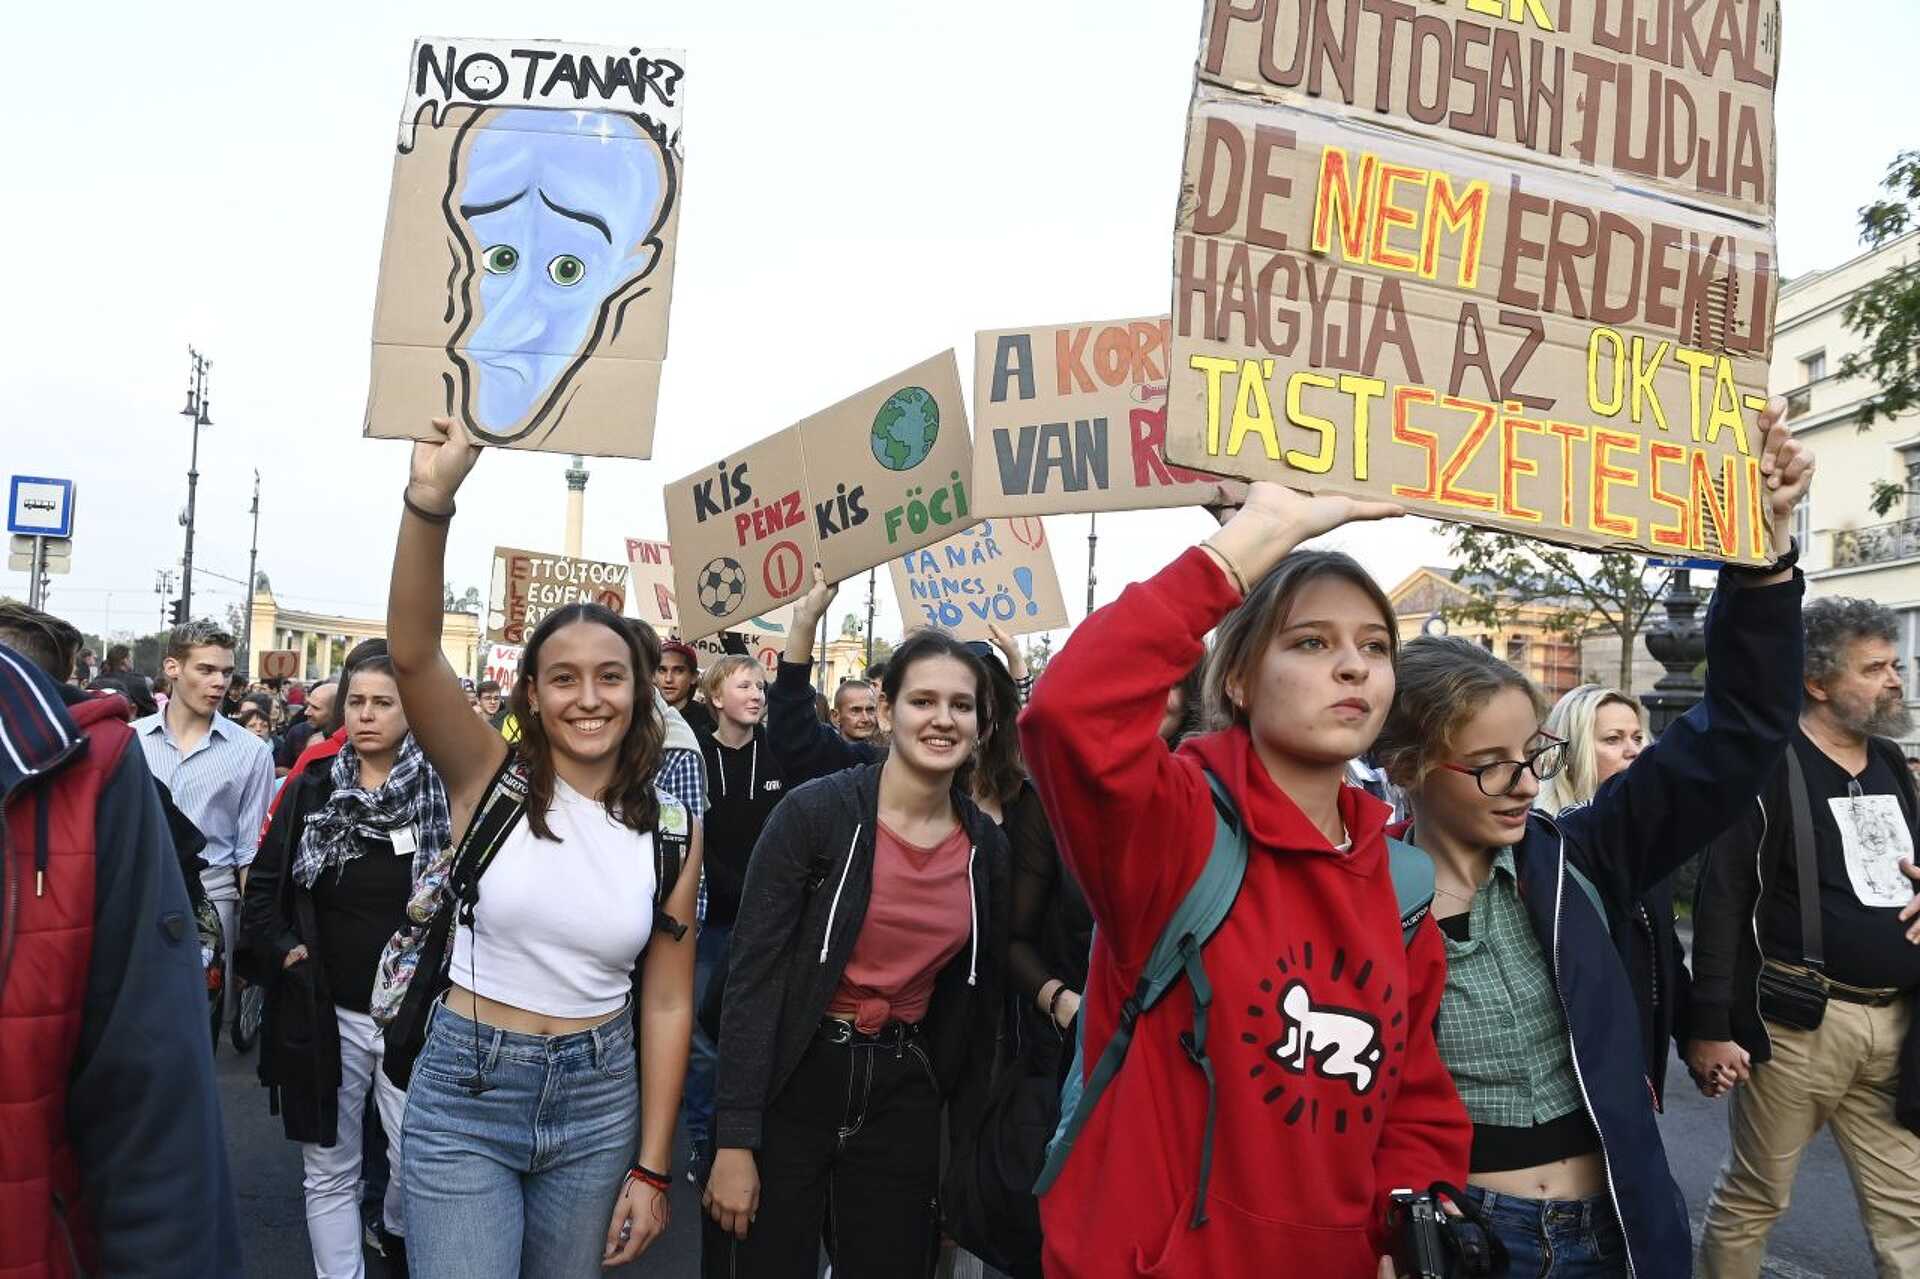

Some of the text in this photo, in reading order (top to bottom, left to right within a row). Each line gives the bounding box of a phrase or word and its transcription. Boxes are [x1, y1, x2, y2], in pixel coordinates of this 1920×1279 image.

[415, 44, 684, 107] NO TANÁR?
[1572, 52, 1765, 204] TUDJA
[1193, 117, 1296, 250] DE
[1312, 145, 1489, 290] NEM
[1179, 235, 1425, 384] HAGYJA
[1448, 302, 1557, 411] AZ
[990, 334, 1035, 402] A
[993, 417, 1109, 495] VAN
[1190, 354, 1765, 559] TÁST SZÉTESNI
[734, 497, 806, 547] PÉNZ
[911, 573, 985, 600] NINCS
